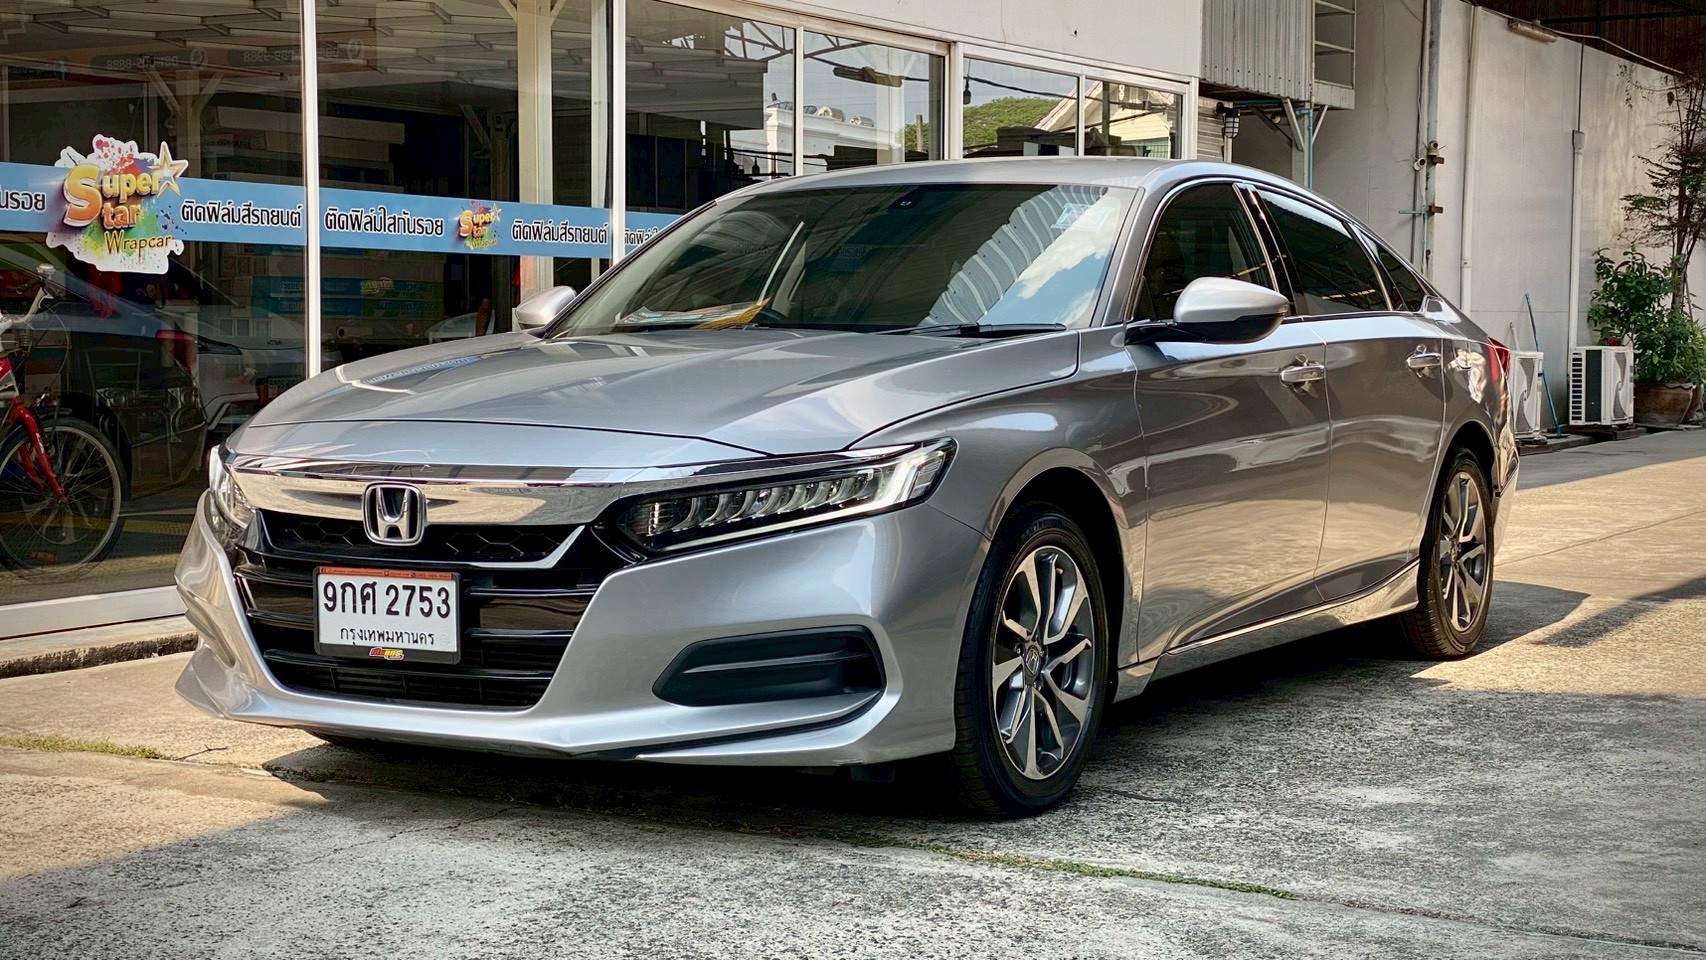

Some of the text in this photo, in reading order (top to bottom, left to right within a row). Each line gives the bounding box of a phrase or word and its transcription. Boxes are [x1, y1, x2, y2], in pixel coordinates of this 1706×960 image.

[181, 201, 302, 228] ติดฟิล์มสีรถยนต์
[512, 220, 608, 243] ติดฟิล์มสีรถยนต์
[104, 230, 173, 262] Wrapcar
[323, 581, 451, 619] 9กศ 2753
[340, 627, 435, 645] กรุงเทพมหานคร
